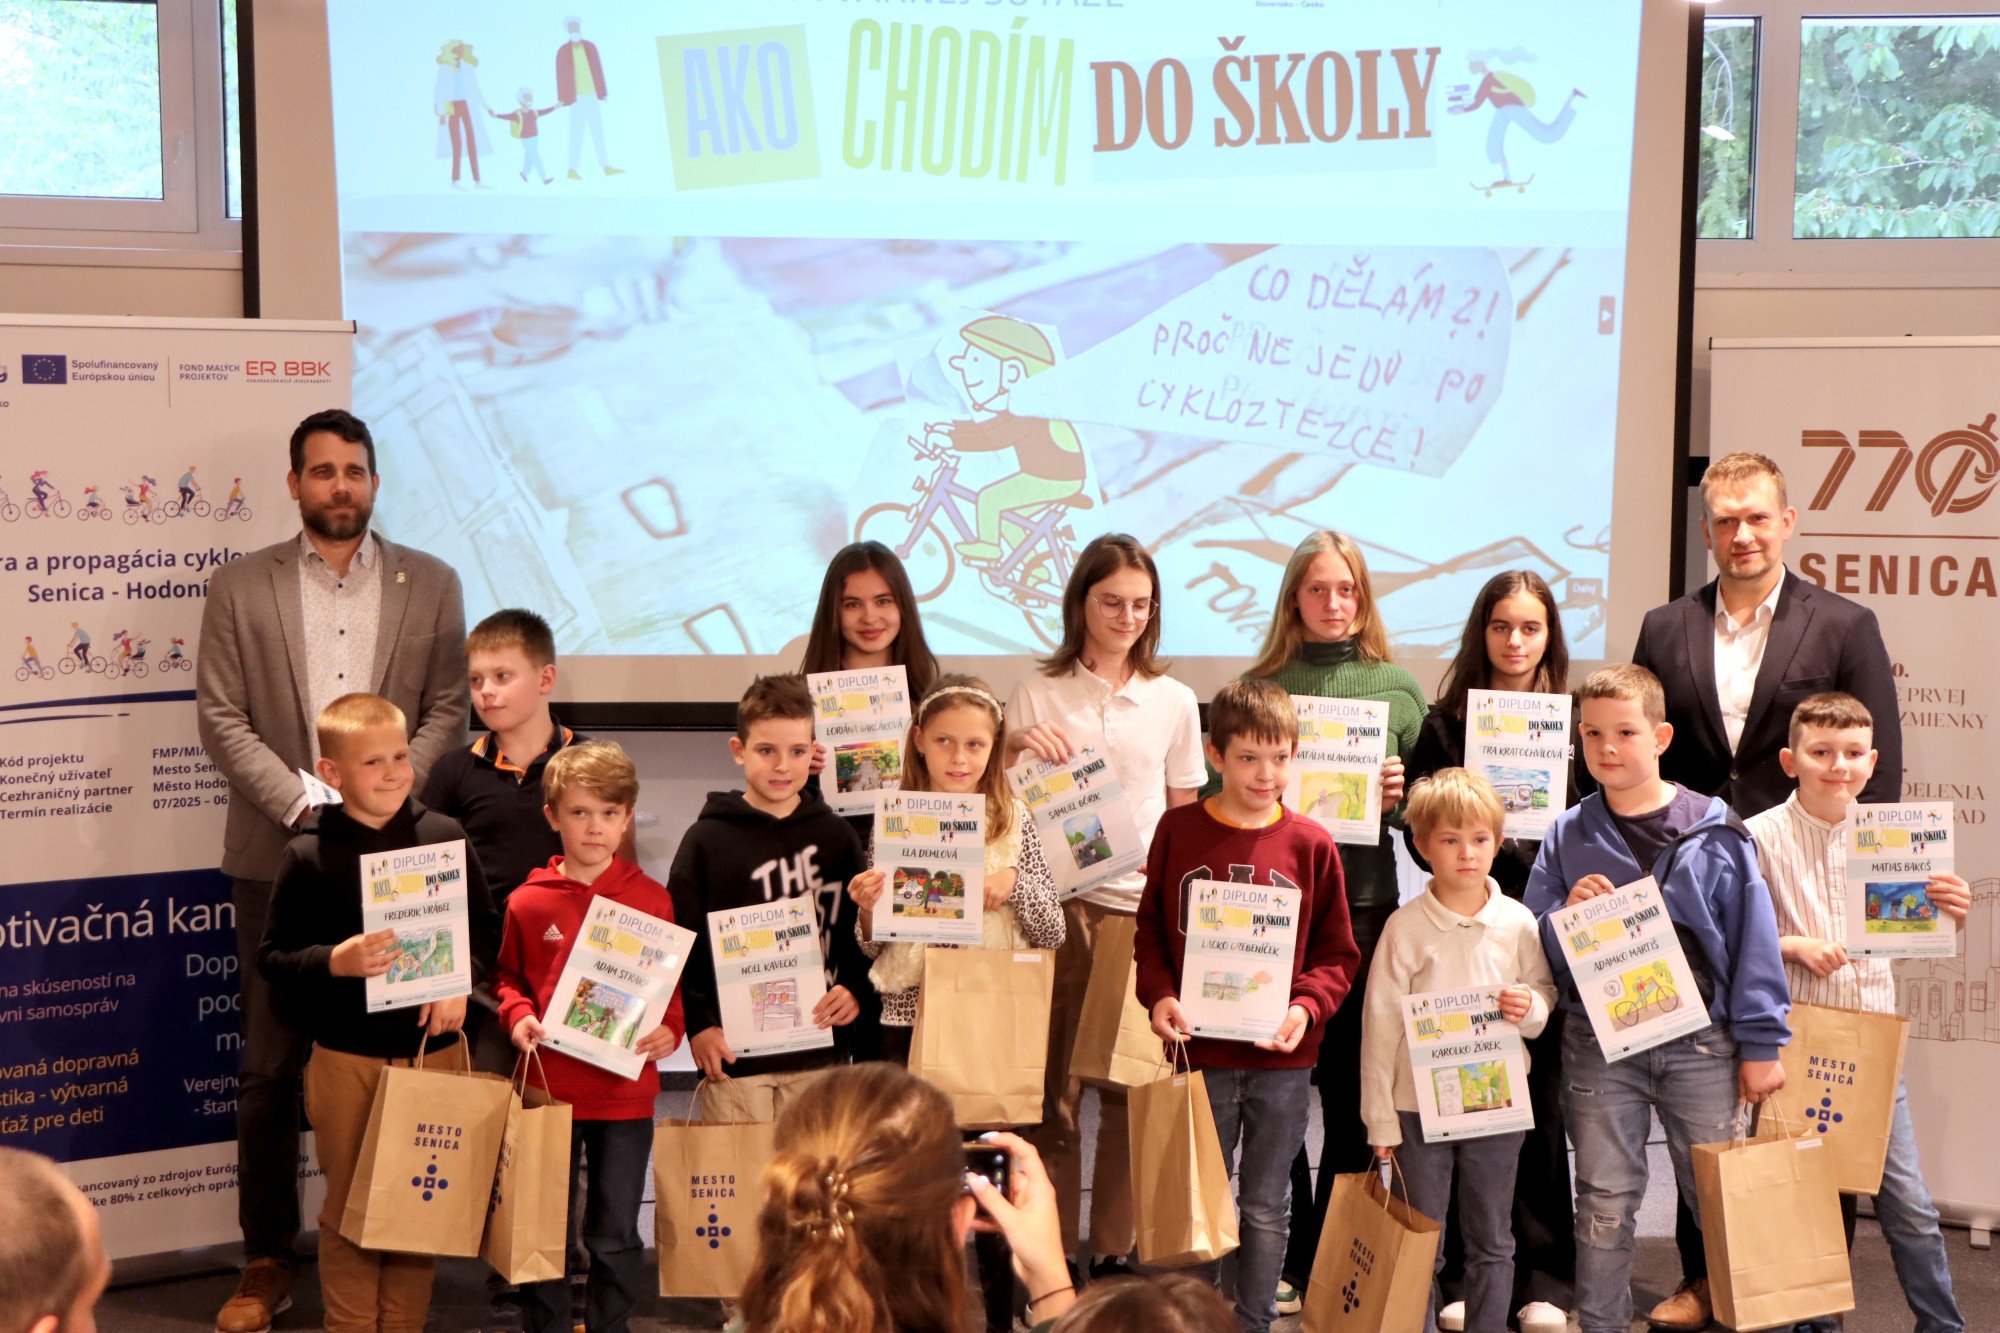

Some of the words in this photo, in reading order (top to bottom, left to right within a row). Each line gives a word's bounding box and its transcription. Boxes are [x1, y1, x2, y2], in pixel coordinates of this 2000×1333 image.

[683, 41, 799, 159] AKO
[842, 16, 1075, 186] CHODÍM
[1090, 57, 1195, 152] DO
[1212, 35, 1442, 148] ŠKOLY
[1248, 262, 1291, 302] CO
[71, 359, 159, 371] Spolufinancovaný
[1152, 313, 1231, 357] PROČ
[1436, 368, 1484, 403] PO
[179, 363, 204, 372] FOND
[206, 362, 240, 372] MALÝCH
[246, 361, 277, 376] ER
[284, 361, 331, 376] BBK
[72, 372, 125, 383] Európskou
[128, 371, 156, 382] úniou
[179, 373, 229, 381] PROJEKTOV
[26, 556, 39, 571] a
[47, 549, 176, 575] propagácia
[1799, 553, 1998, 597] SENICA
[28, 582, 105, 603] Senica
[127, 579, 208, 600] Hodoní
[837, 675, 879, 688] DIPLOM
[1498, 697, 1541, 710] DIPLOM
[1908, 687, 1966, 706] PRVEJ
[1318, 703, 1360, 717] DIPLOM
[1528, 720, 1539, 731] DO
[1899, 711, 1988, 730] ZMIENKY
[1347, 725, 1358, 737] DO
[153, 746, 208, 759] FMP/MI/
[0, 756, 24, 768] Kód
[28, 753, 84, 768] projektu
[153, 764, 191, 776] Mesto
[195, 762, 219, 774] Sen
[1072, 769, 1084, 781] DO
[0, 770, 56, 785] Konečný
[153, 780, 191, 792] Město
[195, 778, 230, 791] Hodo
[0, 787, 80, 803] Cezhraničný
[84, 785, 134, 799] partner
[1901, 782, 1986, 801] DELENIA
[153, 795, 201, 809] 07/2025
[907, 798, 952, 811] DIPLOM
[0, 805, 46, 820] Termín
[50, 802, 113, 817] realizácie
[1048, 802, 1077, 820] SAMUEL
[1878, 810, 1923, 822] DIPLOM
[939, 820, 951, 831] DO
[1911, 831, 1922, 843] DO
[393, 852, 437, 870] DIPLOM
[425, 873, 437, 886] DO
[751, 844, 824, 900] THE
[1222, 889, 1268, 904] DIPLOM
[384, 907, 421, 921] FREDERIK
[1584, 895, 1629, 920] DIPLOM
[0, 899, 154, 949] tivačná
[740, 908, 785, 926] DIPLOM
[1252, 914, 1264, 926] DO
[1622, 916, 1636, 930] DO
[618, 912, 664, 939] DIPLOM
[775, 929, 787, 941] DO
[186, 953, 238, 980] Dop
[593, 960, 619, 976] ADAM
[741, 963, 761, 976] NOEL
[23, 972, 112, 998] skúseností
[115, 973, 136, 988] na
[1434, 993, 1481, 1009] DIPLOM
[27, 998, 119, 1021] samospráv
[1471, 1013, 1483, 1025] DO
[1431, 1045, 1472, 1059] KAROLKO
[53, 1048, 139, 1076] dopravná
[1809, 1055, 1856, 1073] MESTO
[1807, 1068, 1854, 1086] SENICA
[0, 1088, 35, 1107] tika
[51, 1076, 129, 1106] výtvarná
[34, 1114, 65, 1135] pre
[70, 1106, 104, 1126] deti
[417, 1122, 463, 1137] MESTO
[414, 1136, 460, 1150] SENICA
[143, 1175, 156, 1185] zo
[159, 1167, 203, 1183] zdrojov
[205, 1163, 239, 1180] Európ
[691, 1174, 736, 1185] MESTO
[111, 1191, 135, 1205] 80%
[147, 1182, 205, 1201] celkových
[691, 1188, 736, 1198] SENICA
[1353, 1237, 1375, 1264] MESTO
[1349, 1248, 1372, 1276] SENICA
